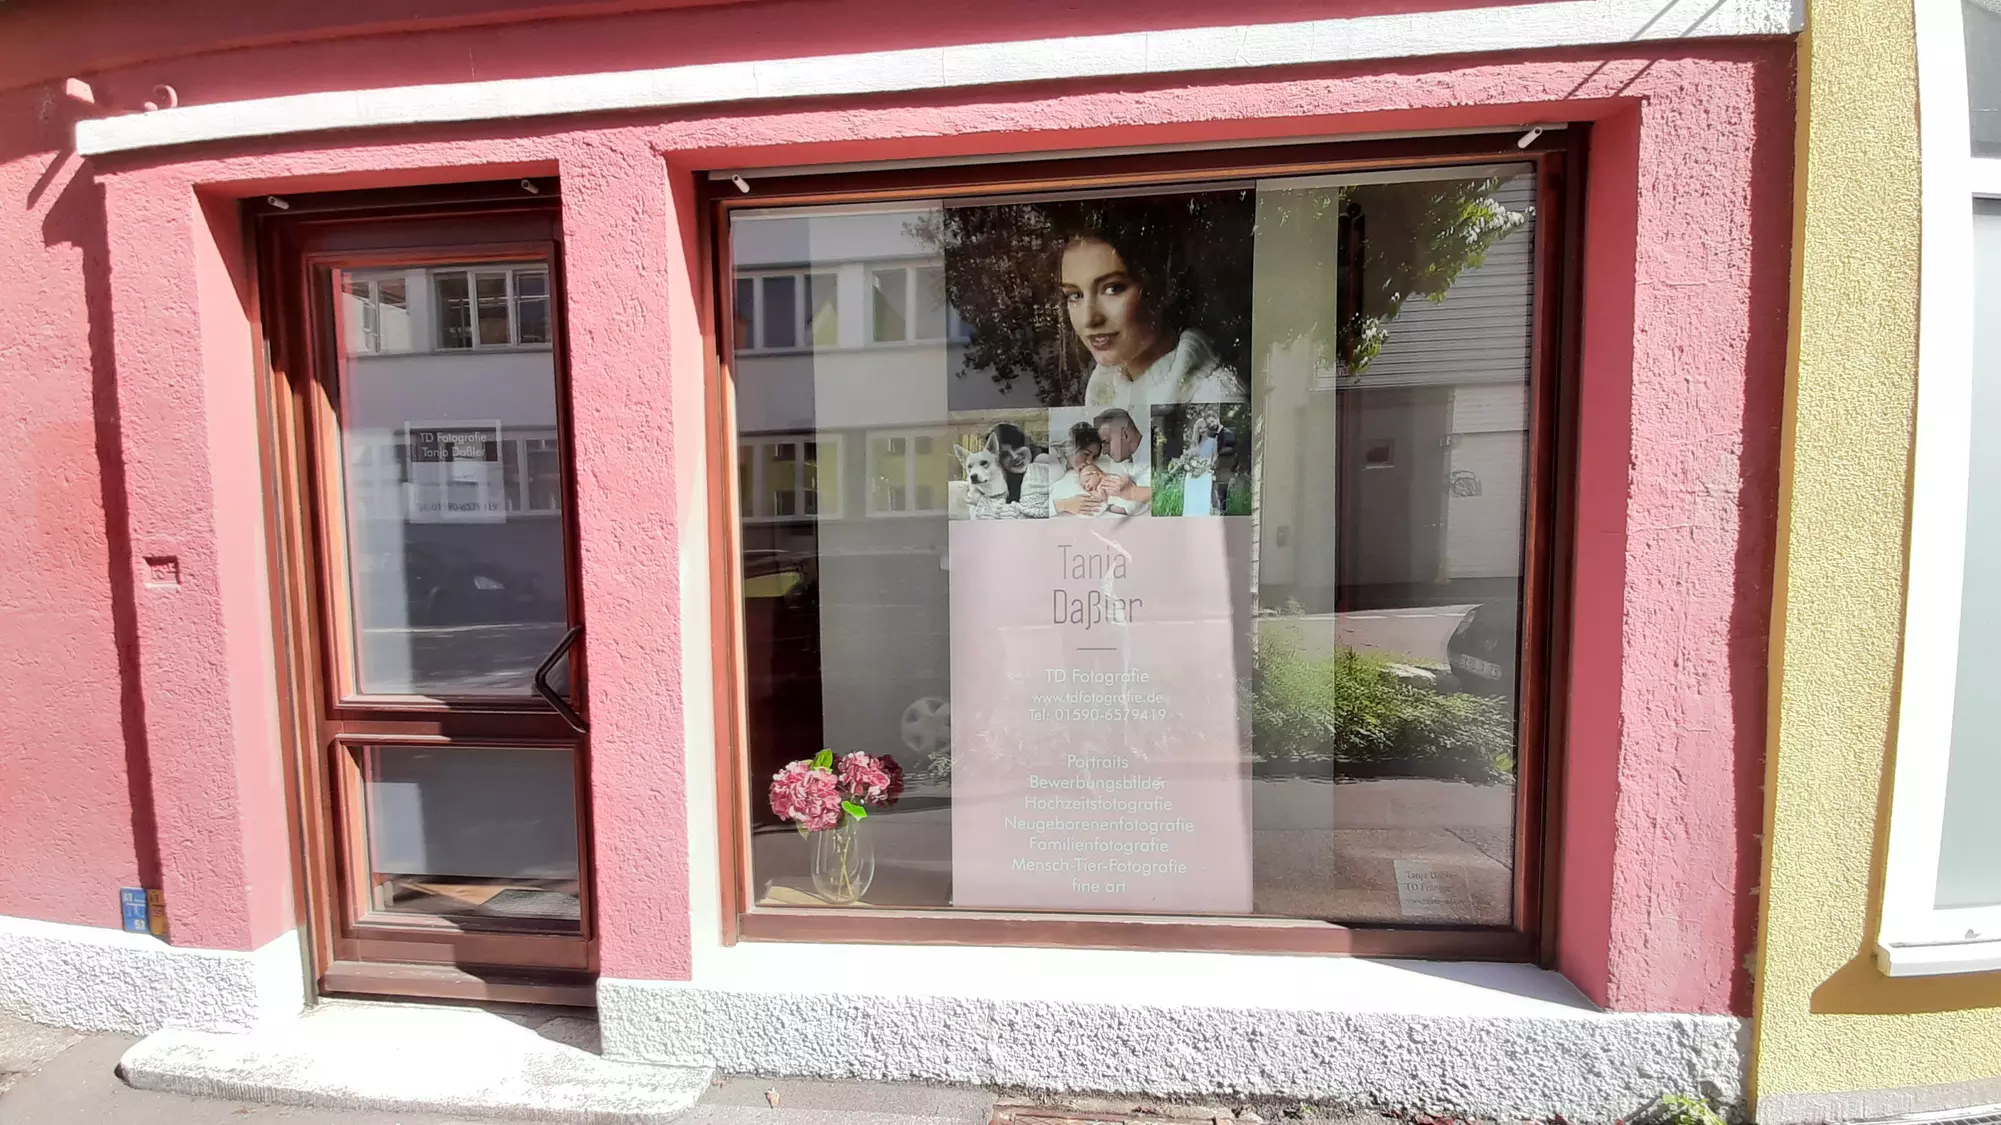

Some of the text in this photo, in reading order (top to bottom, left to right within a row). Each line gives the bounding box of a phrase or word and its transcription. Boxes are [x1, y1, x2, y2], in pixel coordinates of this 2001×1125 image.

[420, 432, 487, 444] TD Fotografie
[422, 447, 448, 459] Tanja
[1057, 544, 1127, 581] Tanja
[1053, 589, 1143, 630] Daßler
[1045, 668, 1149, 686] TD Fotografie
[1032, 690, 1163, 705] www.tdfotografie.de
[1029, 709, 1167, 721] Tel: 01590-6579419
[1067, 755, 1128, 769] Portraits
[1029, 776, 1168, 792] Bewerbungsbilder
[1025, 796, 1173, 814] Hochzeitsfotografie
[1004, 817, 1195, 835] Neugeborenenfotografie
[1029, 837, 1169, 855] Familienfotografie
[1012, 858, 1187, 876] Mensch-Tier-Fotografie
[1072, 878, 1126, 893] fine art
